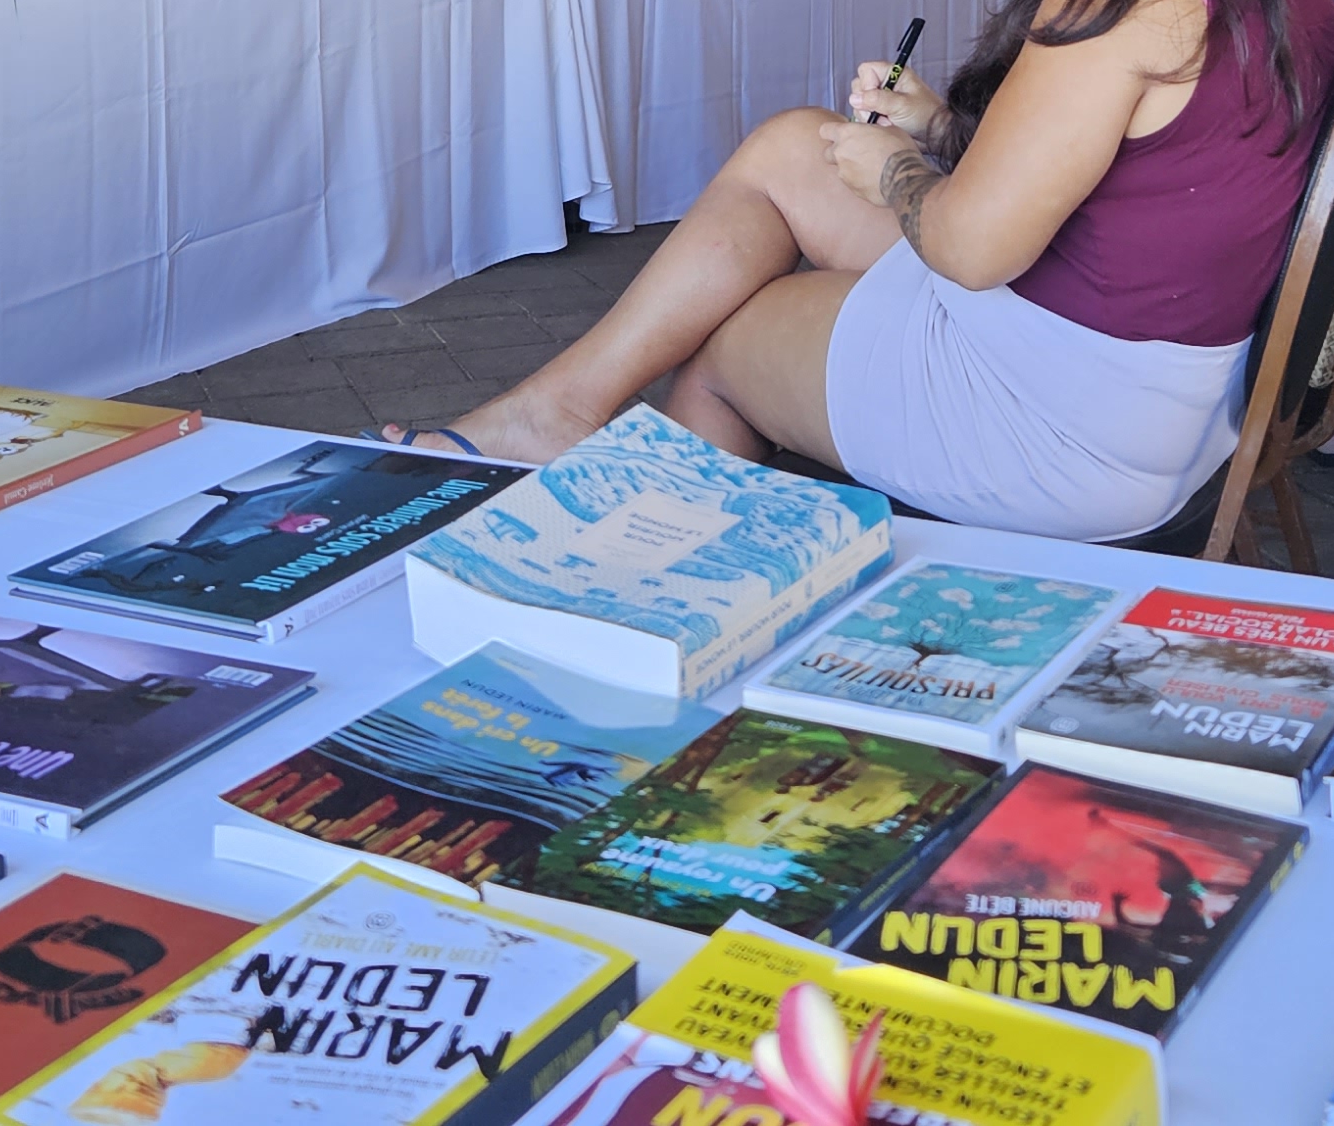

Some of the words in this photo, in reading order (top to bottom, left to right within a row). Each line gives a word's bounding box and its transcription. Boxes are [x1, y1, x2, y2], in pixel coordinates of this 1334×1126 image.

[438, 478, 490, 509] Une
[626, 521, 685, 542] MOURIR
[628, 511, 681, 532] MONDE
[680, 525, 703, 538] LE
[326, 520, 371, 561] sous
[622, 530, 664, 549] POUR
[283, 539, 328, 583] mon
[238, 565, 293, 595] lit
[1168, 617, 1225, 634] BEAU
[1293, 633, 1329, 648] UN
[440, 687, 505, 723] forêt
[459, 677, 513, 705] LEDUN
[419, 700, 481, 731] dans
[506, 712, 532, 730] la
[515, 697, 568, 722] MARIN
[1149, 699, 1315, 738] LEDUN
[474, 722, 517, 742] cri
[1182, 721, 1304, 754] MARIN
[518, 735, 560, 758] Un
[599, 844, 720, 884] royaume
[709, 850, 791, 877] pour
[721, 871, 777, 903] Un
[965, 893, 1017, 918] BÊTE
[1018, 896, 1103, 919] AUCUNE
[880, 910, 1104, 963] LEDUN
[232, 953, 491, 1017] LEDUN
[947, 958, 1176, 1011] MARIN
[245, 1006, 513, 1082] MARIN
[879, 1077, 945, 1101] SIGN
